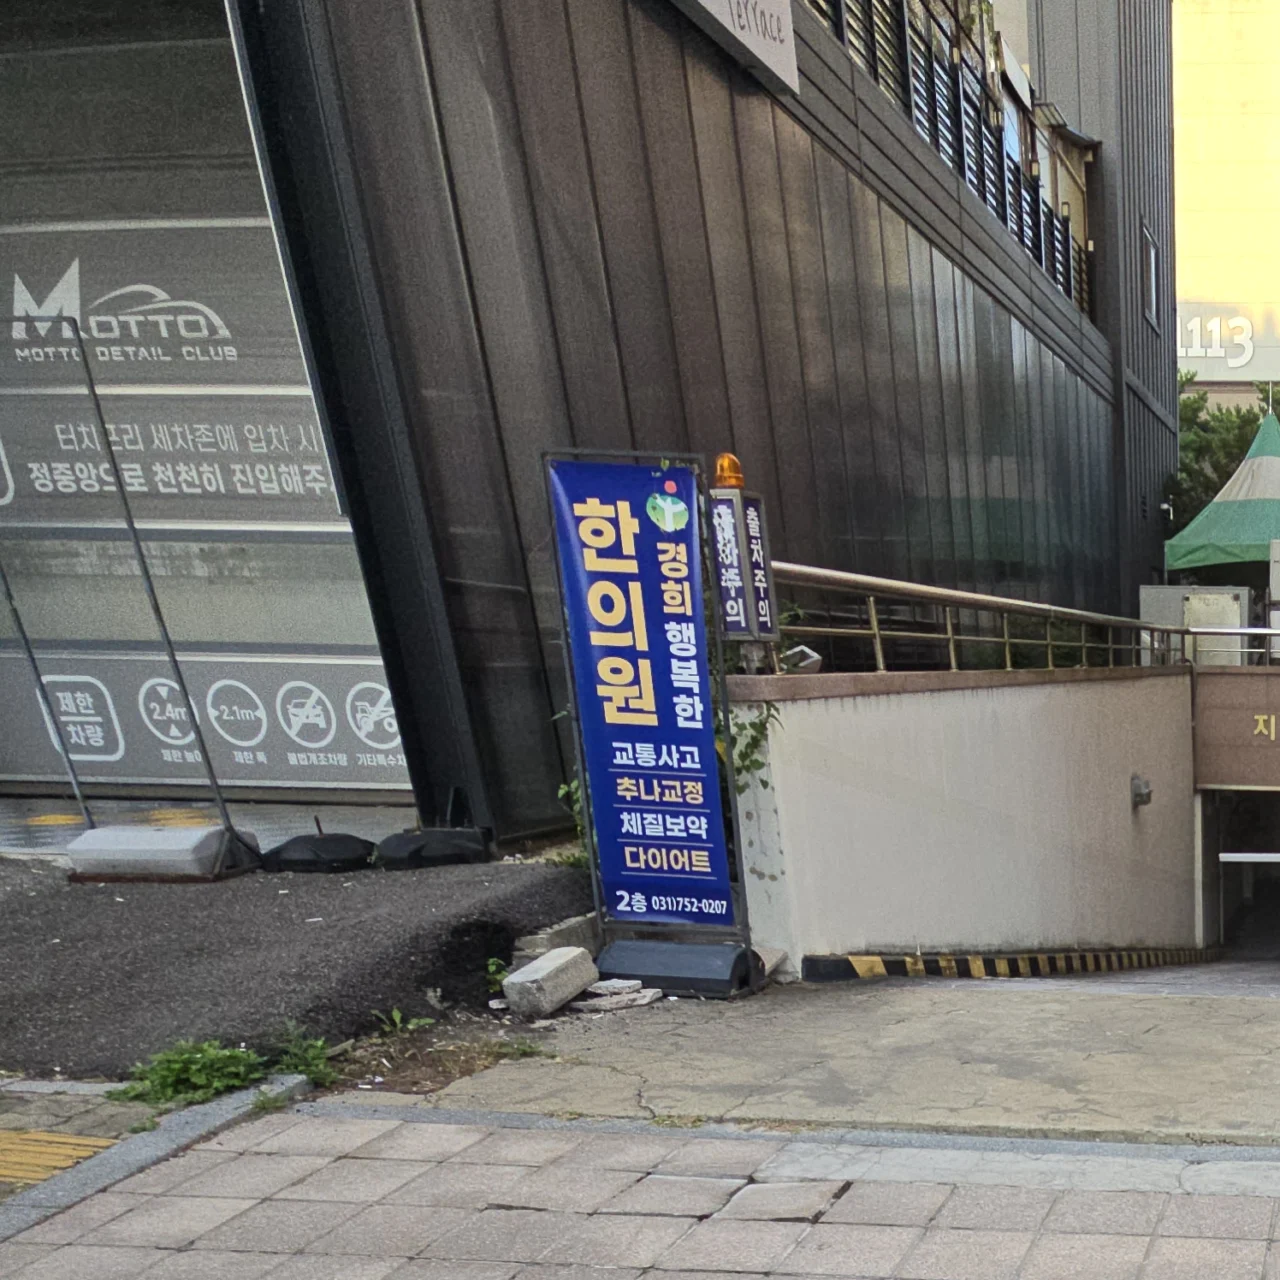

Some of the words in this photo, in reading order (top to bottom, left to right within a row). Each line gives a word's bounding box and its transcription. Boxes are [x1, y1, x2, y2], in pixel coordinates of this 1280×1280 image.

[97, 346, 172, 361] DETAIL
[181, 346, 238, 361] CLUB
[55, 424, 145, 452] 터치프리
[152, 424, 239, 452] 세차존에
[245, 425, 290, 453] 입차
[298, 424, 319, 452] 시
[153, 462, 225, 494] 천천히
[230, 463, 336, 495] 진입해주
[573, 497, 658, 726] 한의원
[56, 691, 95, 715] 제한
[219, 705, 255, 721] 2.1m
[66, 723, 105, 747] 차량
[612, 741, 702, 769] 교통사고
[616, 776, 704, 805] 추나교정
[620, 811, 708, 840] 체질보약
[624, 846, 712, 873] 다이어트
[615, 890, 648, 913] 2층
[651, 895, 728, 915] 031)752-0207
